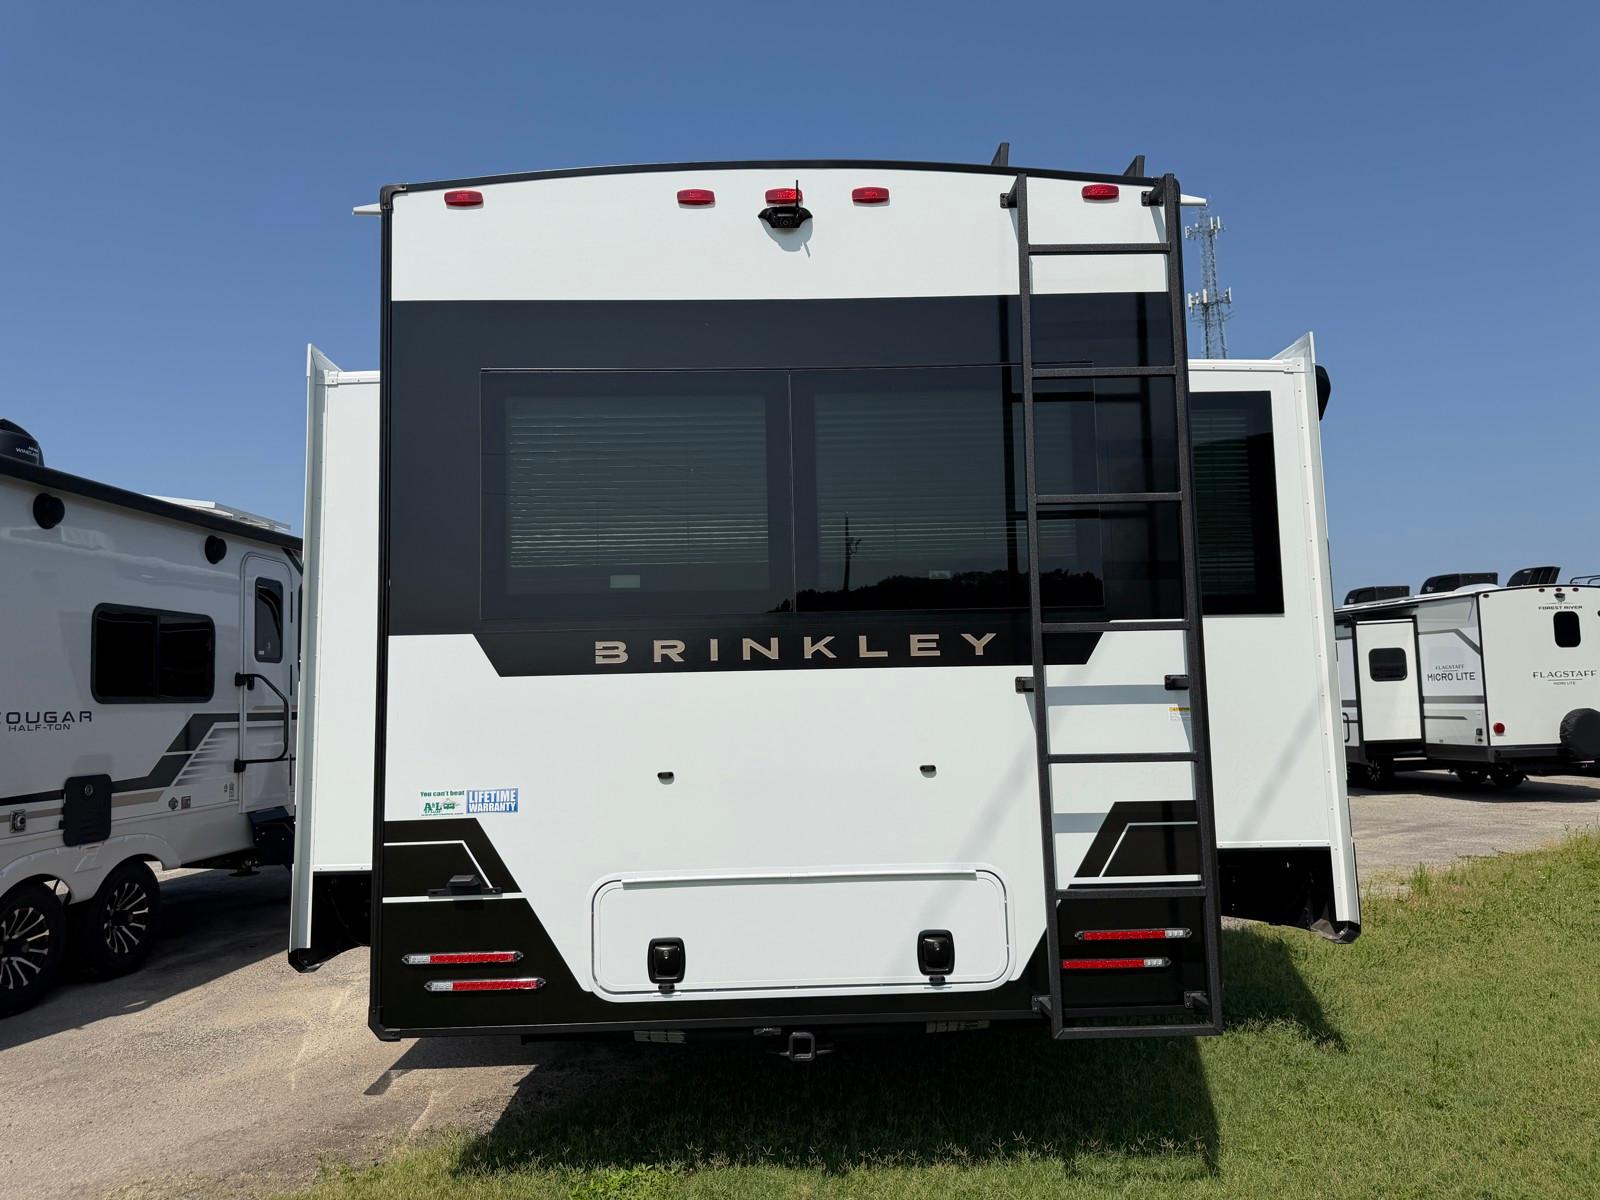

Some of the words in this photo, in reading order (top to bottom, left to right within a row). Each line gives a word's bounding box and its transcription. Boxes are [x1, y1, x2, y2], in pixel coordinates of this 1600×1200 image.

[595, 633, 996, 664] BRINKLEY
[1427, 673, 1454, 681] MICRO
[1456, 671, 1476, 681] LITE
[1532, 670, 1597, 678] FLAGSTAFF
[0, 711, 92, 724] OUGAR
[8, 723, 71, 732] HALF-TON
[468, 790, 516, 803] LIFETIME
[468, 802, 517, 812] WARRANTY
